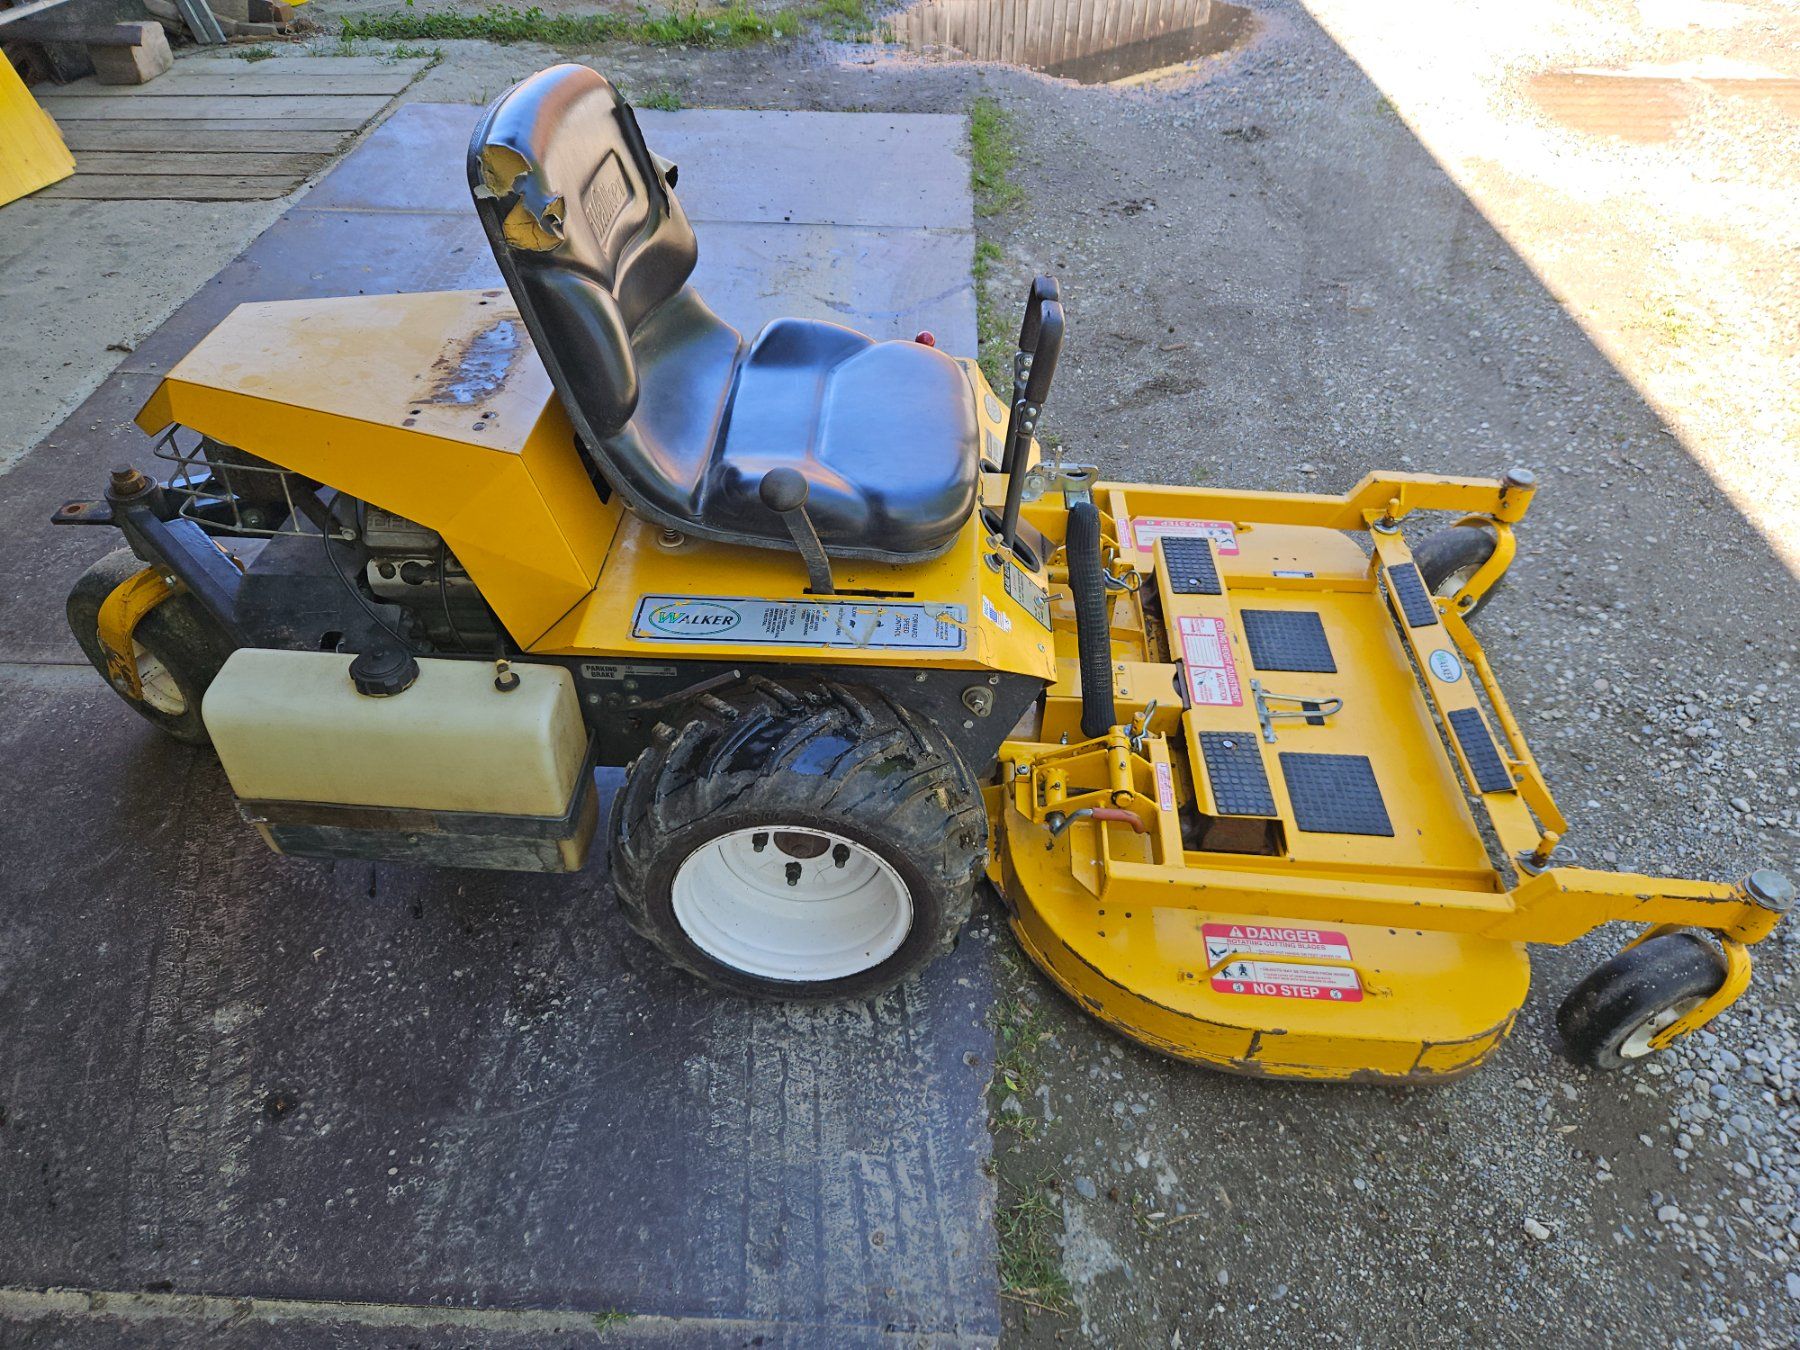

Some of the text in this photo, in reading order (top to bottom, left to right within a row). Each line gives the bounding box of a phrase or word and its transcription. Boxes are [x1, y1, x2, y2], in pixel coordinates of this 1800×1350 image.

[658, 611, 734, 625] WALKER
[1246, 927, 1320, 943] DANGER
[1264, 941, 1296, 949] CUTTING
[1297, 943, 1327, 951] BLADES
[1252, 983, 1320, 998] NO STEP
